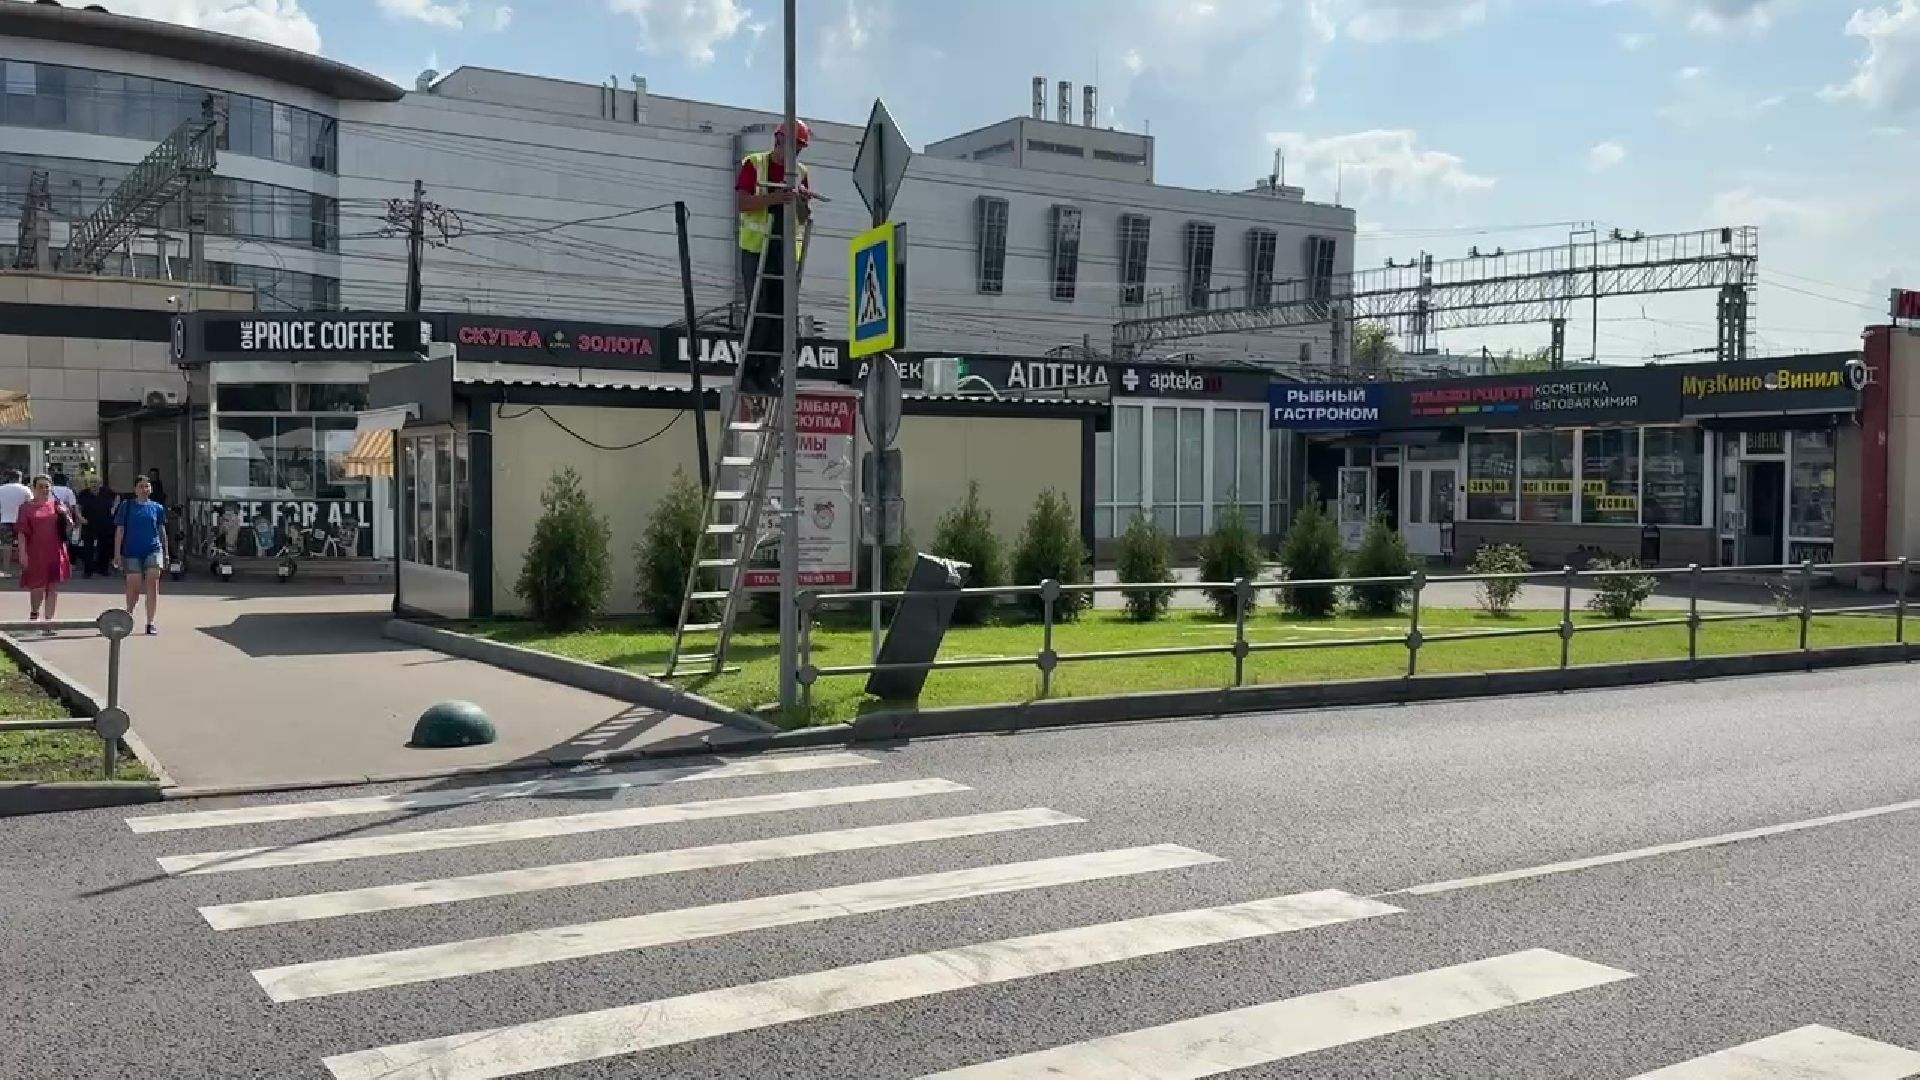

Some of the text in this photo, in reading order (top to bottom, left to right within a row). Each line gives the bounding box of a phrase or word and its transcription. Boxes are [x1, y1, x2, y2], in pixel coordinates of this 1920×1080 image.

[240, 321, 253, 349] ONE
[255, 321, 316, 349] PRICE
[320, 321, 394, 350] COFFEE
[459, 327, 652, 355] СКУПКА ЗОЛОТА
[678, 336, 818, 368] ШАУА
[1008, 361, 1109, 389] АПТЕКА
[1535, 381, 1609, 395] КОСМЕТИКА
[1682, 373, 1762, 400] МузКино
[1287, 387, 1366, 403] РЫБНЫЙ
[1592, 395, 1638, 409] ХИМИЯ
[796, 401, 848, 415] МБАРД
[1535, 398, 1591, 411] БЫТОВАЯ
[796, 415, 841, 428] КУПКА
[1274, 407, 1379, 421] ГАСТРОНОМ
